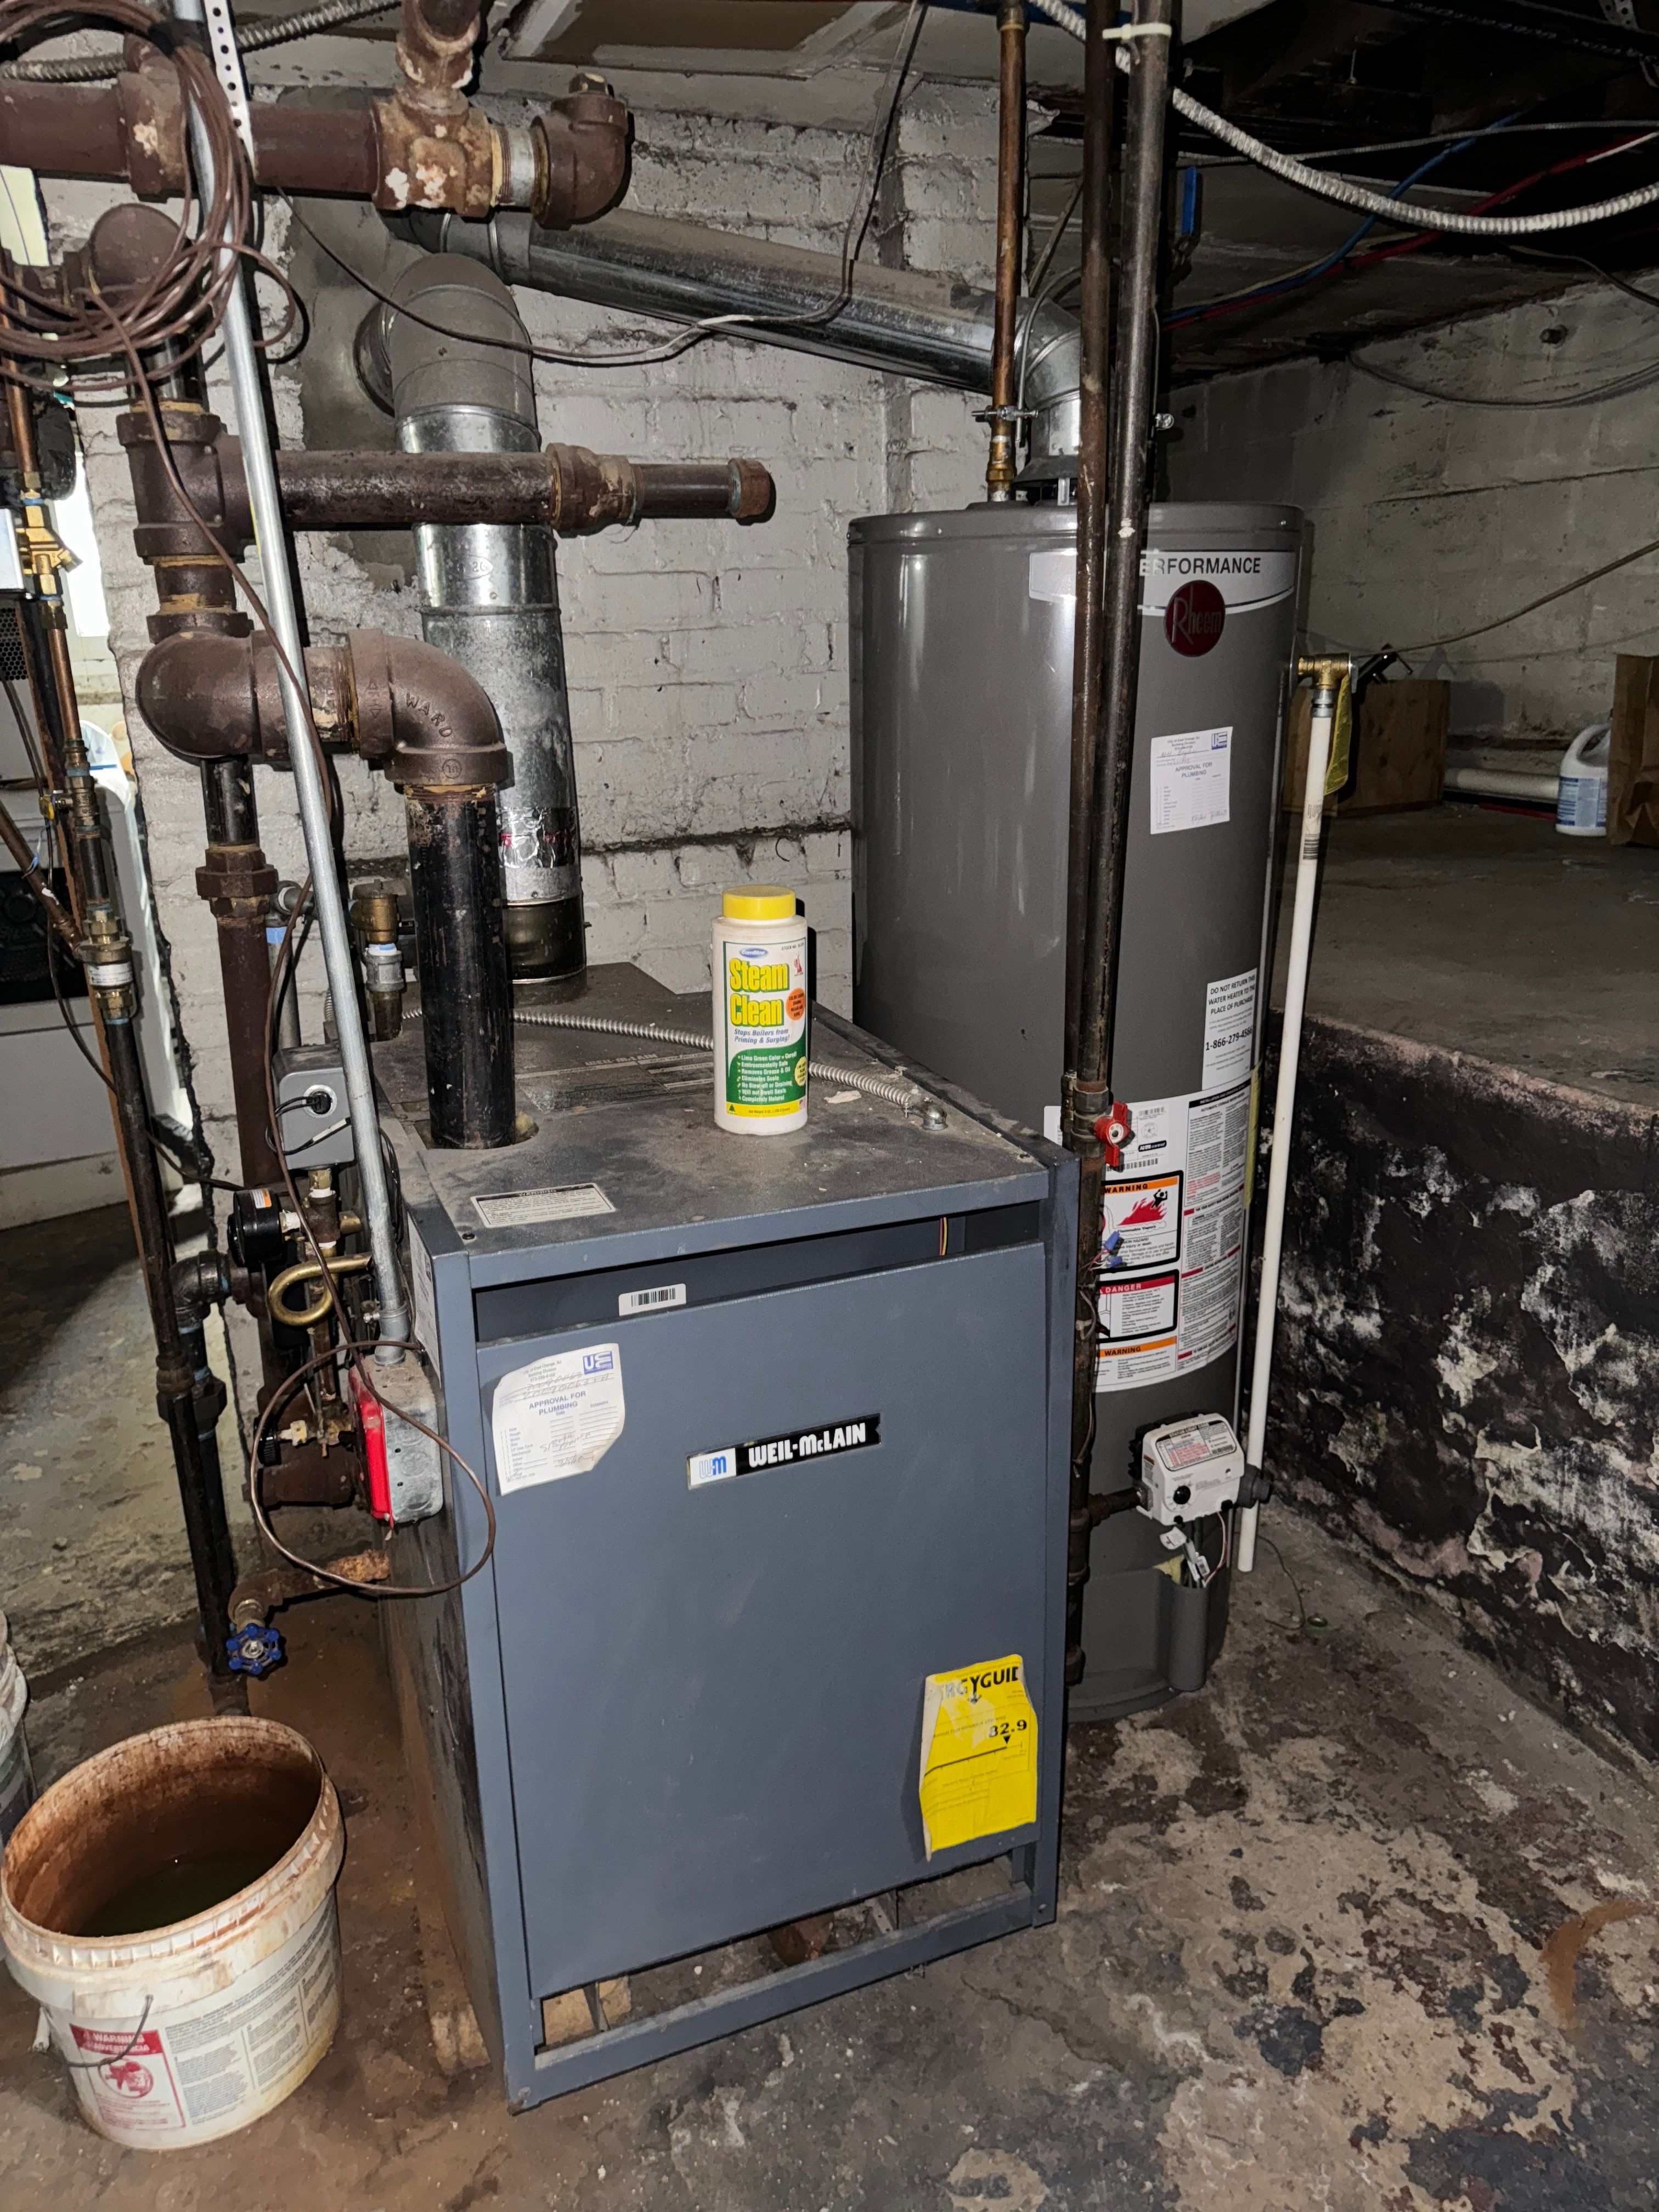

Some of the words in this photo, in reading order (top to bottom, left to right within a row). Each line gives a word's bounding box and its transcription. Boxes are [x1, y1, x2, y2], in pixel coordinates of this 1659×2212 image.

[1141, 557, 1261, 574] ERFORMANCE
[1171, 584, 1222, 646] Rheem
[407, 693, 453, 737] WARD
[1175, 764, 1201, 772] APPROVAL
[1181, 770, 1207, 778] PLUMBING
[730, 957, 789, 992] Steam
[1231, 979, 1248, 988] RETURN
[1208, 995, 1226, 1005] WATER
[1227, 990, 1243, 1000] HEATER
[730, 993, 784, 1027] Clean
[1210, 1005, 1226, 1015] PLACE
[1234, 995, 1254, 1008] PURCHASE
[734, 1028, 751, 1036] Stops
[735, 1036, 757, 1045] Priming
[766, 1035, 790, 1043] Surging!
[1104, 1183, 1148, 1193] WARNING
[1105, 1283, 1141, 1293] DANGER
[1104, 1346, 1141, 1356] WARNING
[529, 1395, 567, 1409] APPROVAL
[571, 1390, 586, 1400] FOR
[539, 1401, 578, 1415] PLUMBING
[989, 1719, 1028, 1738] 82.9
[94, 2032, 145, 2043] WARNING
